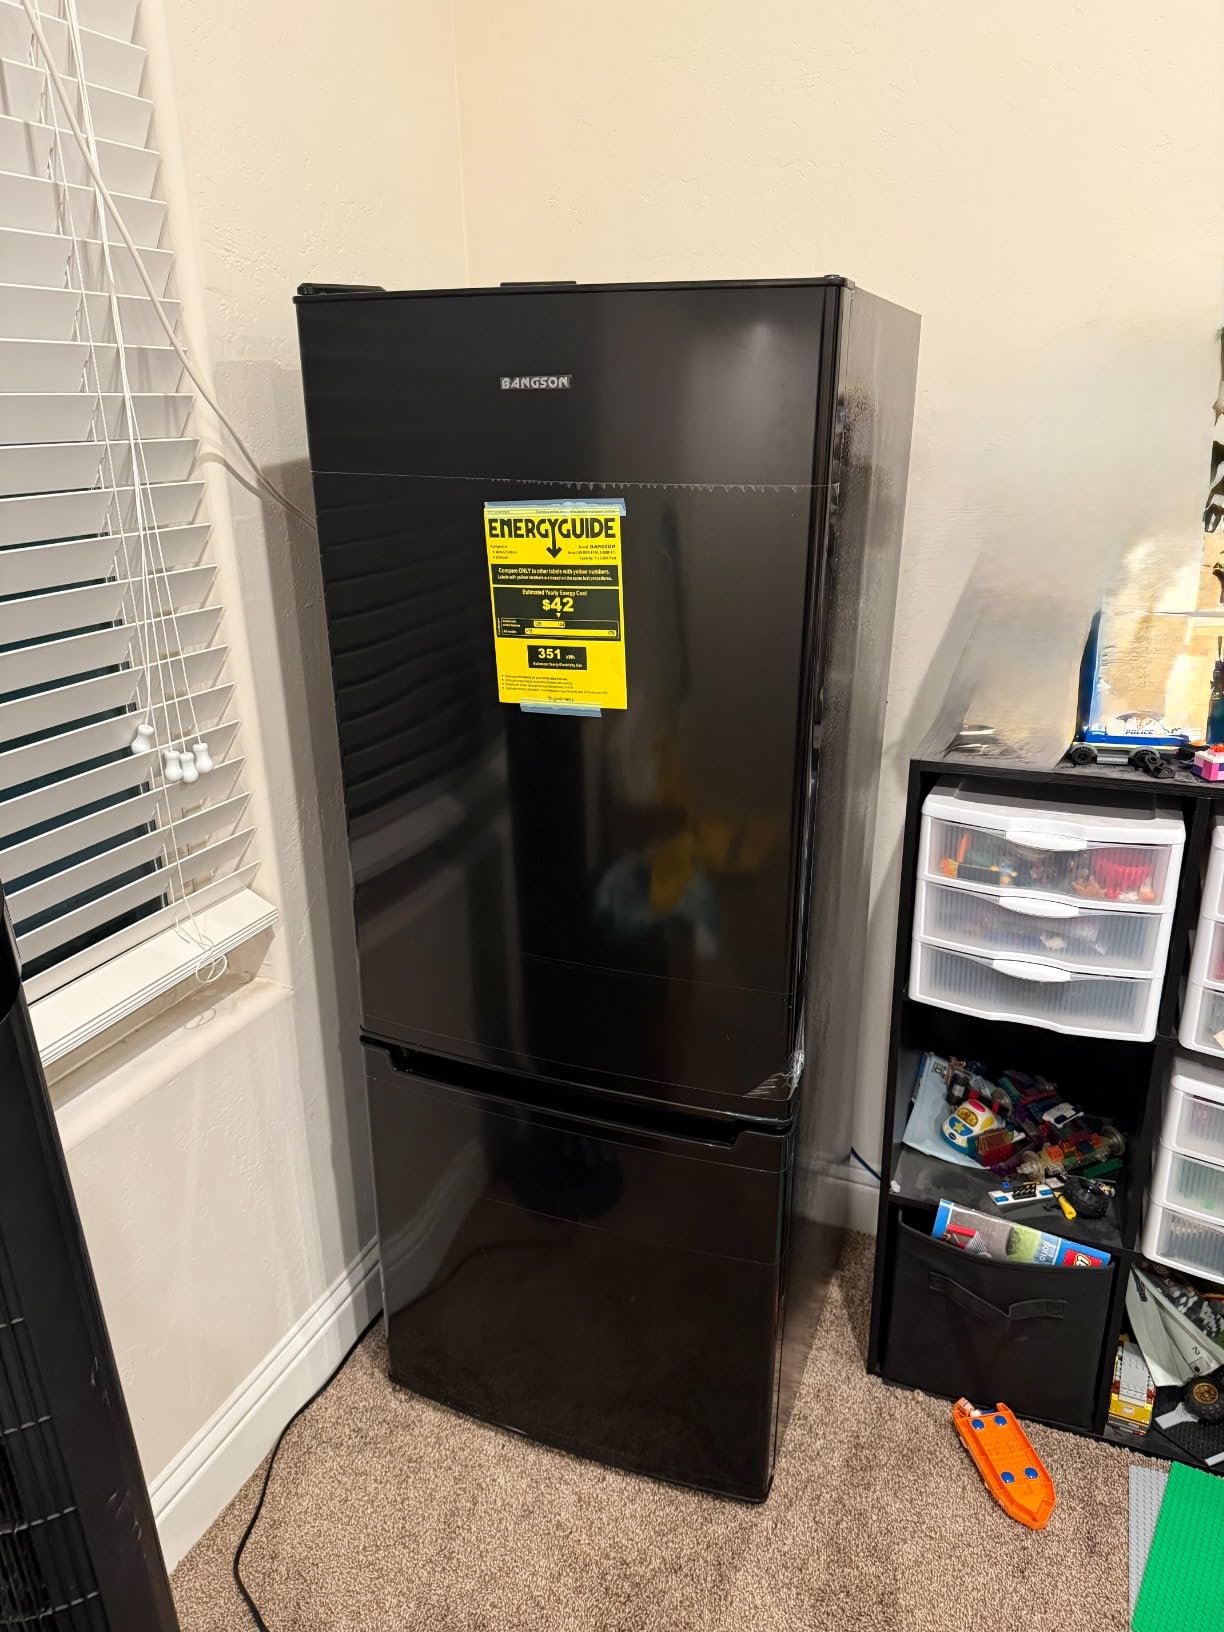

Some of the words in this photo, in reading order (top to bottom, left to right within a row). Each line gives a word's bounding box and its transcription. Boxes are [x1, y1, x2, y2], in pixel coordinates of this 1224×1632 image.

[501, 376, 569, 390] BANGSON
[488, 517, 616, 539] ENERGYGUIDE
[498, 567, 518, 575] Compare
[573, 568, 588, 576] yellow
[545, 589, 559, 597] Yearly
[542, 597, 575, 612] $42
[538, 648, 561, 660] 351
